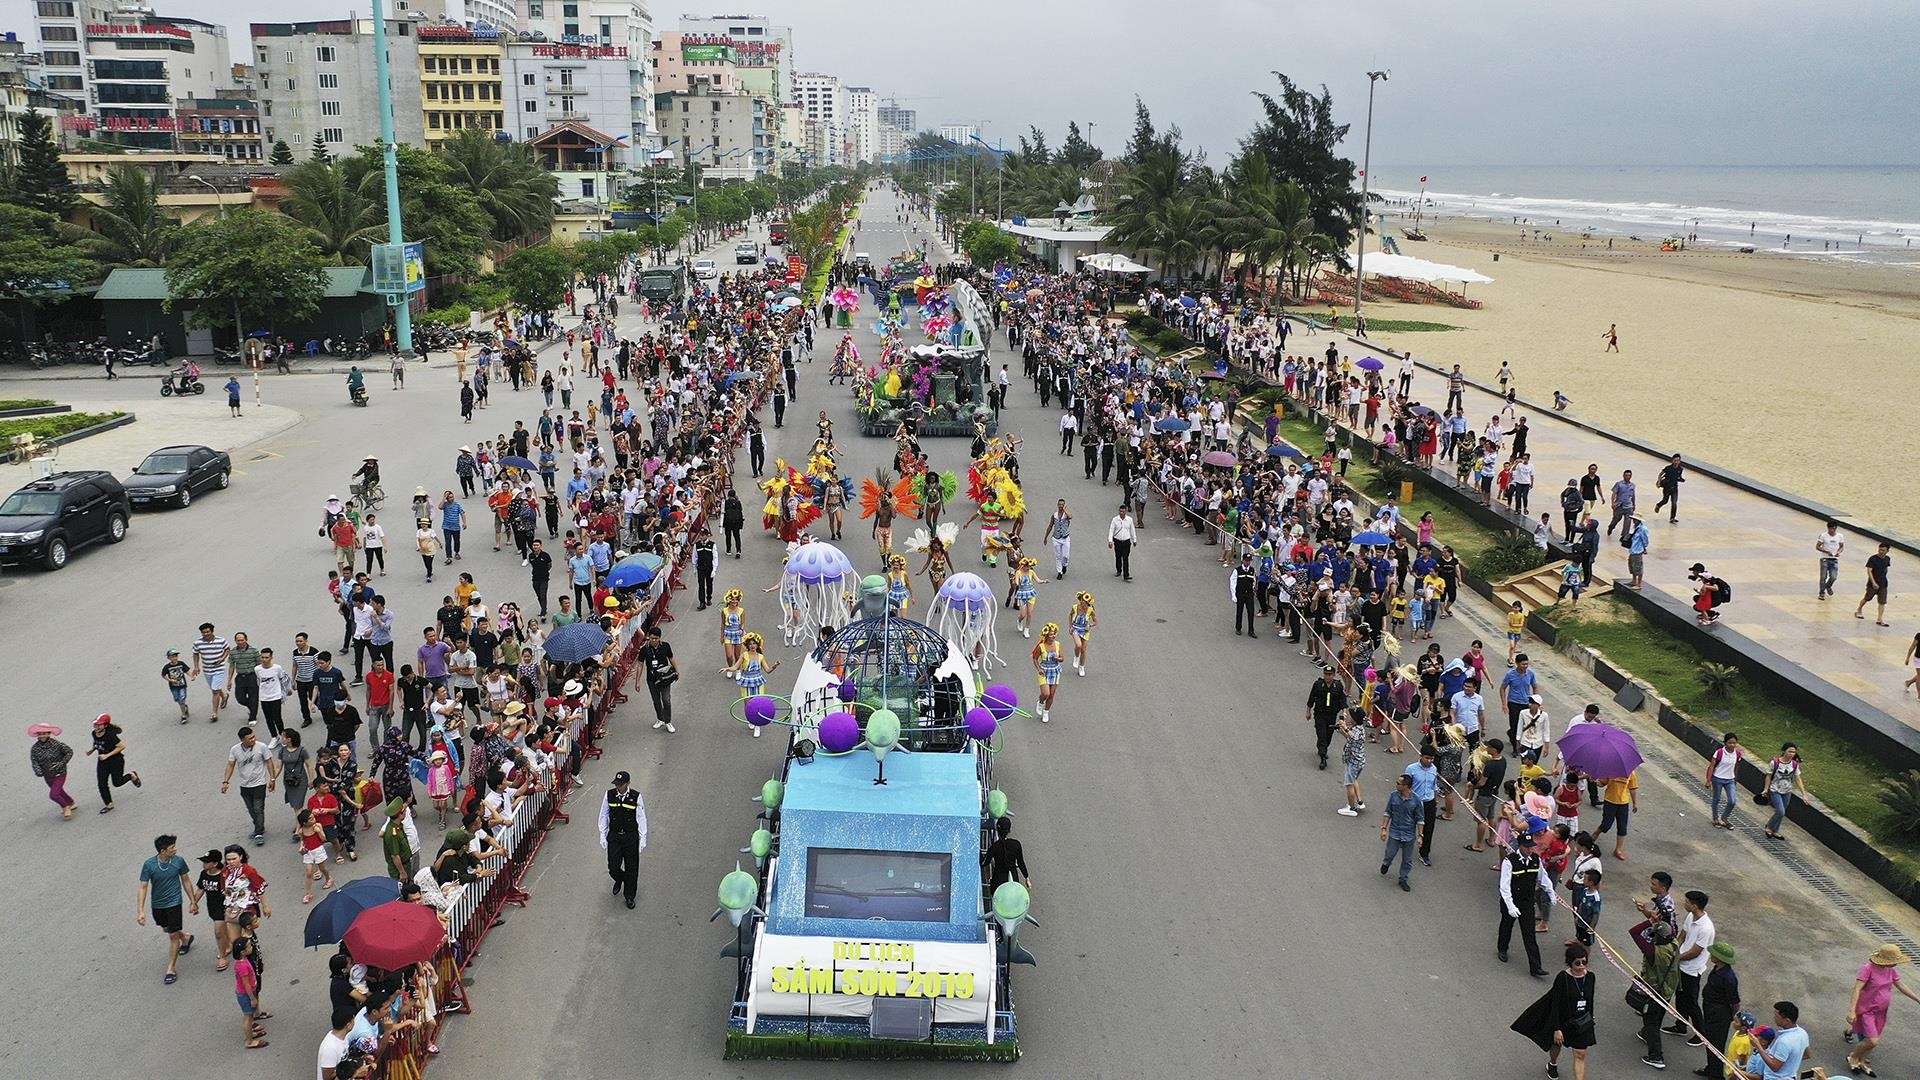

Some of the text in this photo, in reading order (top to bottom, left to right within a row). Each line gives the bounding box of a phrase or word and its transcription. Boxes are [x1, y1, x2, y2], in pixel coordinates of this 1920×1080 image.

[561, 33, 597, 43] Hotel
[833, 942, 914, 963] DU LỊCH
[904, 971, 975, 999] 2019
